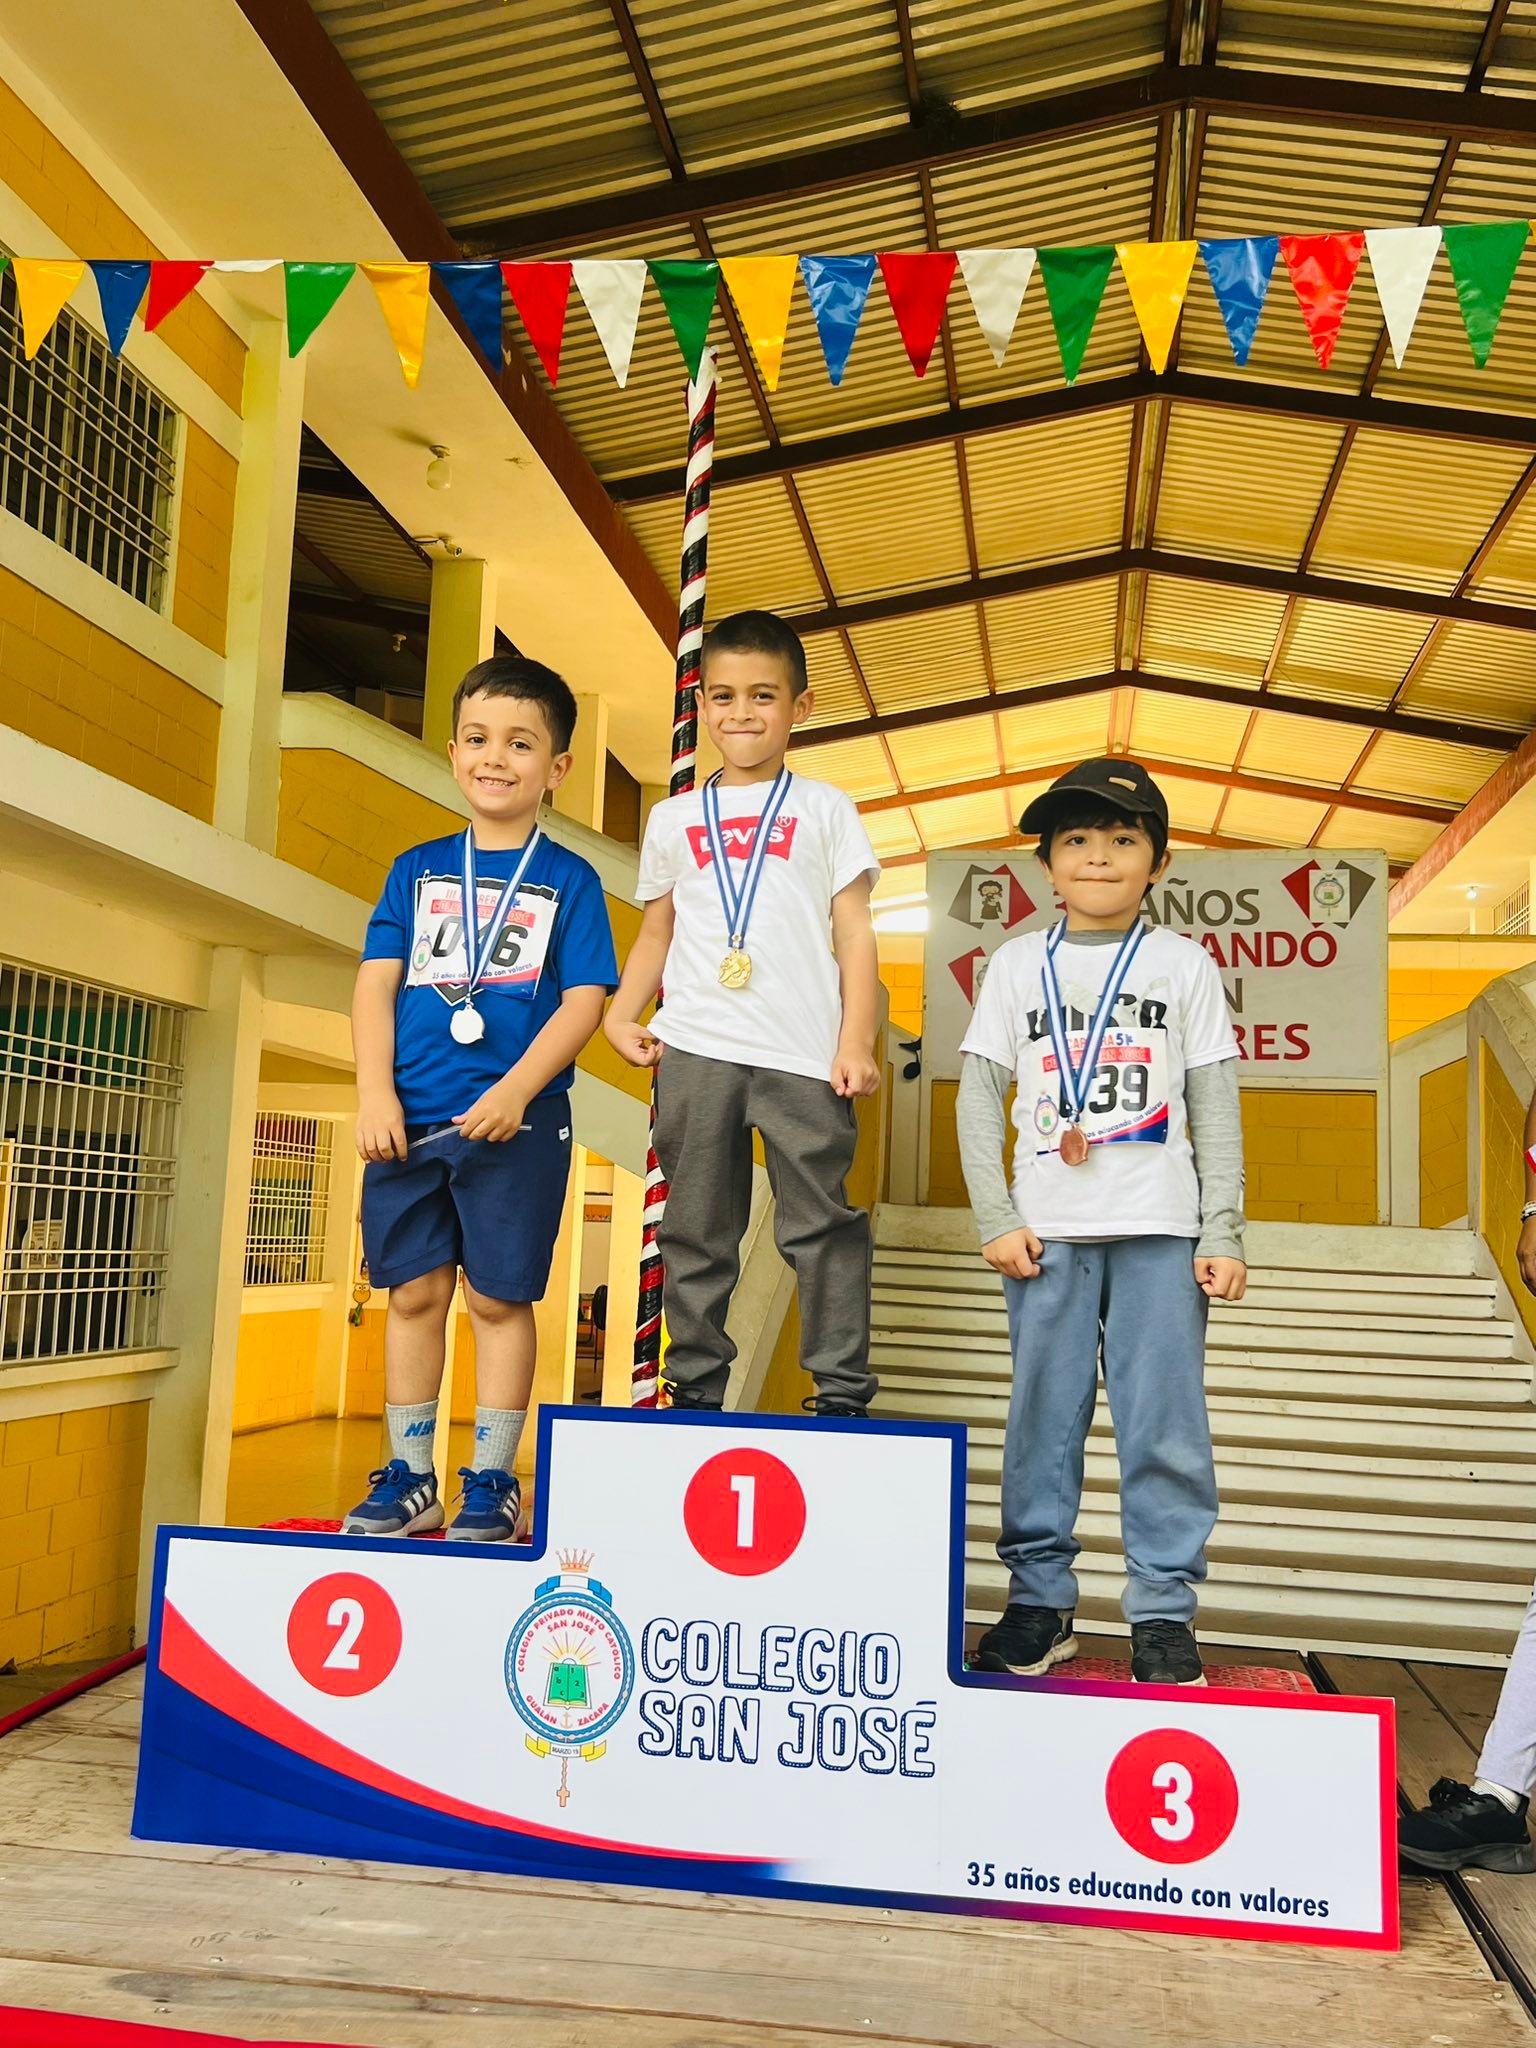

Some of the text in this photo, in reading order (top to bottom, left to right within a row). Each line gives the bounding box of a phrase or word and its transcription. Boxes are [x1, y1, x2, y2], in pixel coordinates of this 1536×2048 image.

[432, 915, 528, 967] 06
[1178, 930, 1338, 968] ANDO
[1235, 1023, 1310, 1060] RES
[730, 1474, 756, 1548] 1
[322, 1597, 366, 1671] 2
[517, 1608, 622, 1681] COLEGIO PRIVADO MIXTO CATOLICO
[547, 1619, 597, 1636] SAN JOSE
[641, 1617, 901, 1700] COLEGIO
[577, 1702, 610, 1727] ZACAPA
[638, 1690, 938, 1778] SAN JOSÉ
[551, 1746, 571, 1755] MARZO
[1150, 1761, 1194, 1841] 3
[967, 1861, 1330, 1918] 35 años educando con valores
